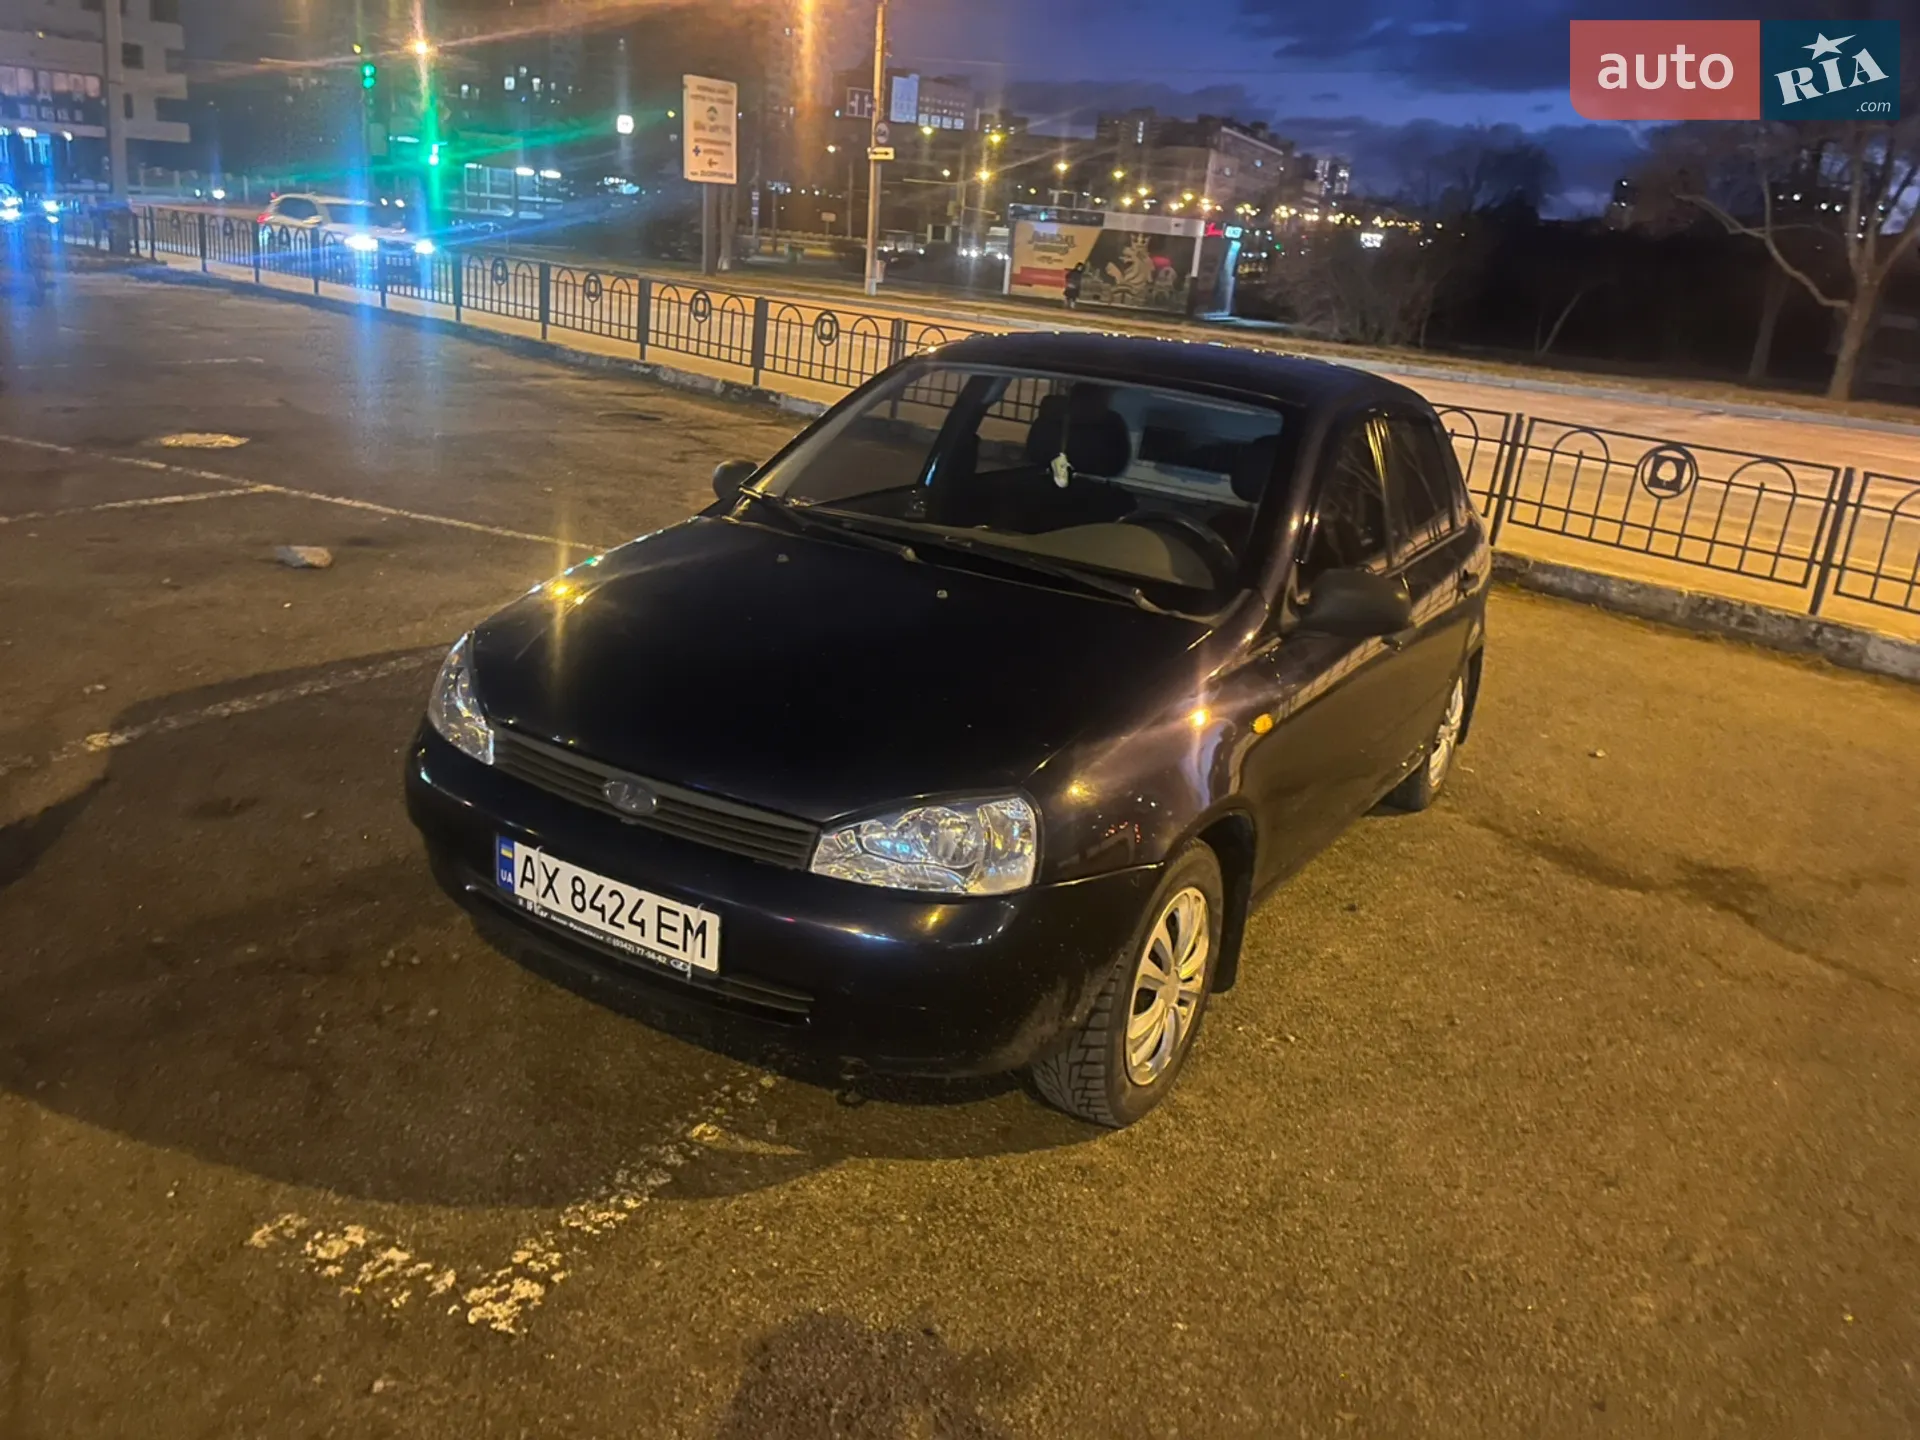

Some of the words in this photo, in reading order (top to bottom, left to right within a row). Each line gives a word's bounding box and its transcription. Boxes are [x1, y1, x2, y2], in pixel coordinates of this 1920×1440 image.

[500, 868, 514, 884] UA
[520, 854, 561, 905] AX
[570, 875, 646, 938] 8424
[656, 904, 707, 959] EM
